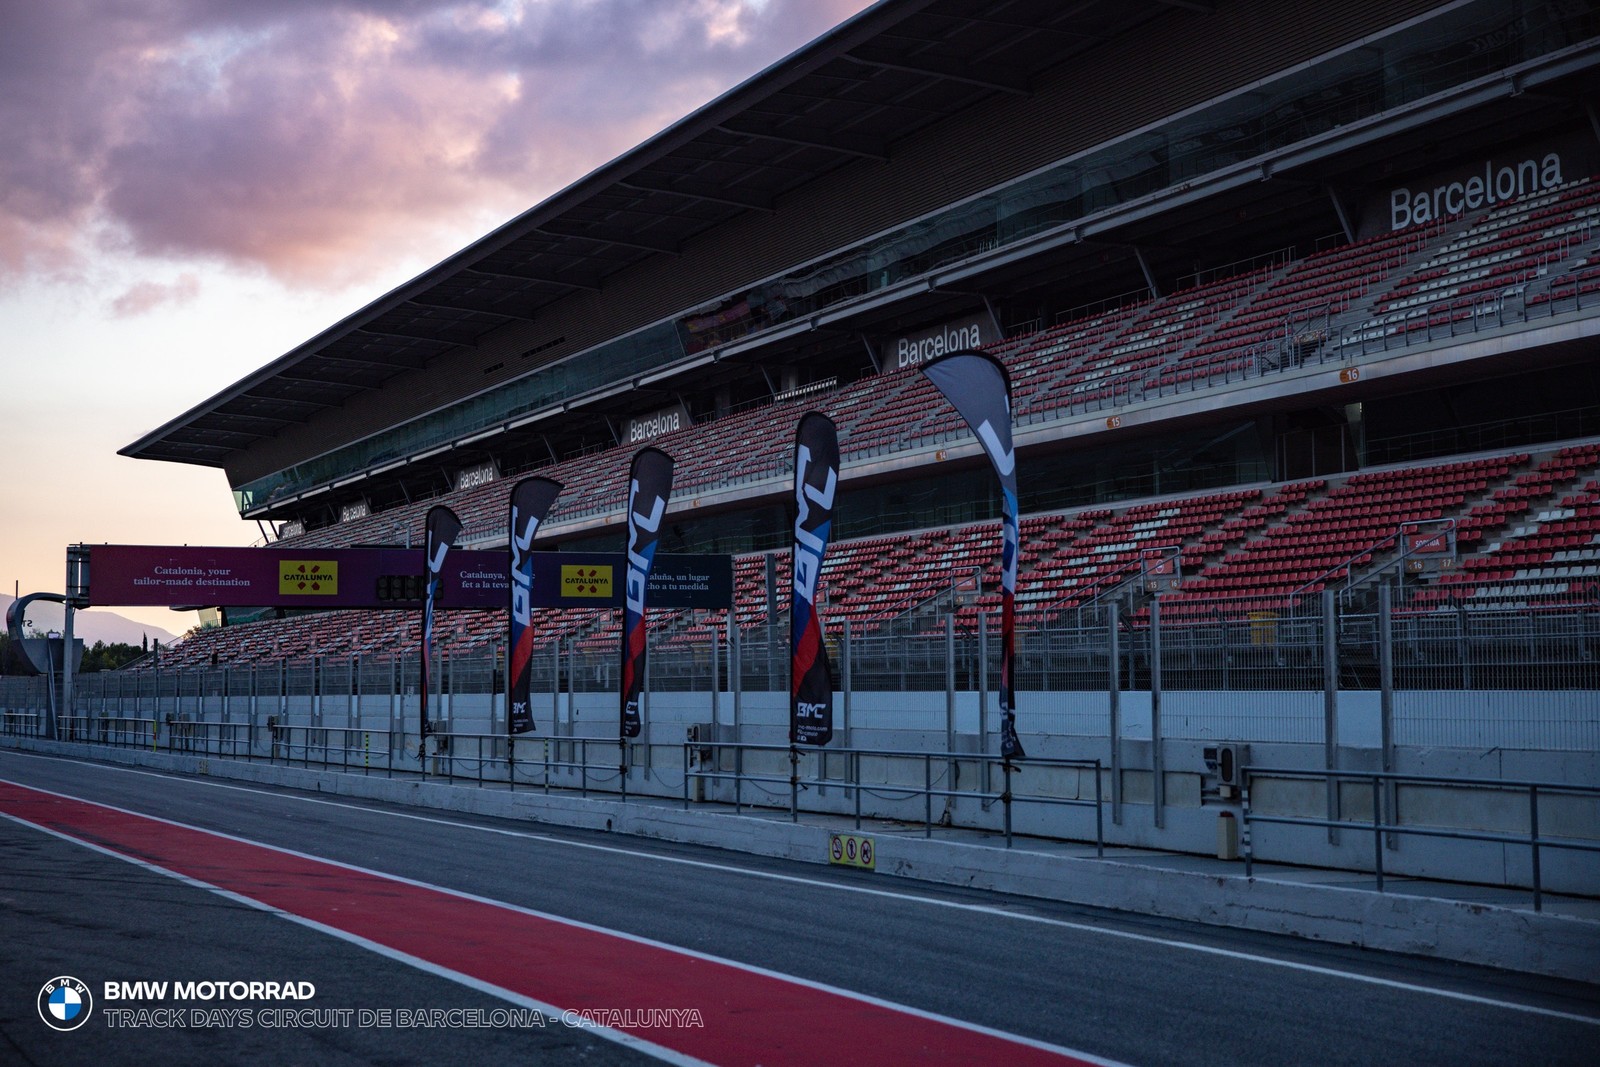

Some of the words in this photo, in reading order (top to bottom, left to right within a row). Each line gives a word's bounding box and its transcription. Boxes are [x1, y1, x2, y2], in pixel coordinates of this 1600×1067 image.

[1391, 152, 1563, 231] Barcelona
[898, 324, 981, 368] Barcelona
[1346, 368, 1358, 381] 16
[630, 411, 680, 443] Barcelona
[1111, 418, 1120, 428] 15
[460, 465, 493, 490] Barcelona
[1414, 561, 1423, 569] 16
[1442, 559, 1451, 567] 17
[154, 566, 206, 577] Catalonia,
[460, 571, 506, 580] Catalunya,
[134, 577, 193, 586] tailor-made
[196, 578, 250, 586] destination
[649, 573, 675, 582] aluña,
[688, 574, 710, 582] lugar
[462, 580, 474, 588] fet
[482, 580, 490, 588] la
[796, 702, 826, 719] BMC
